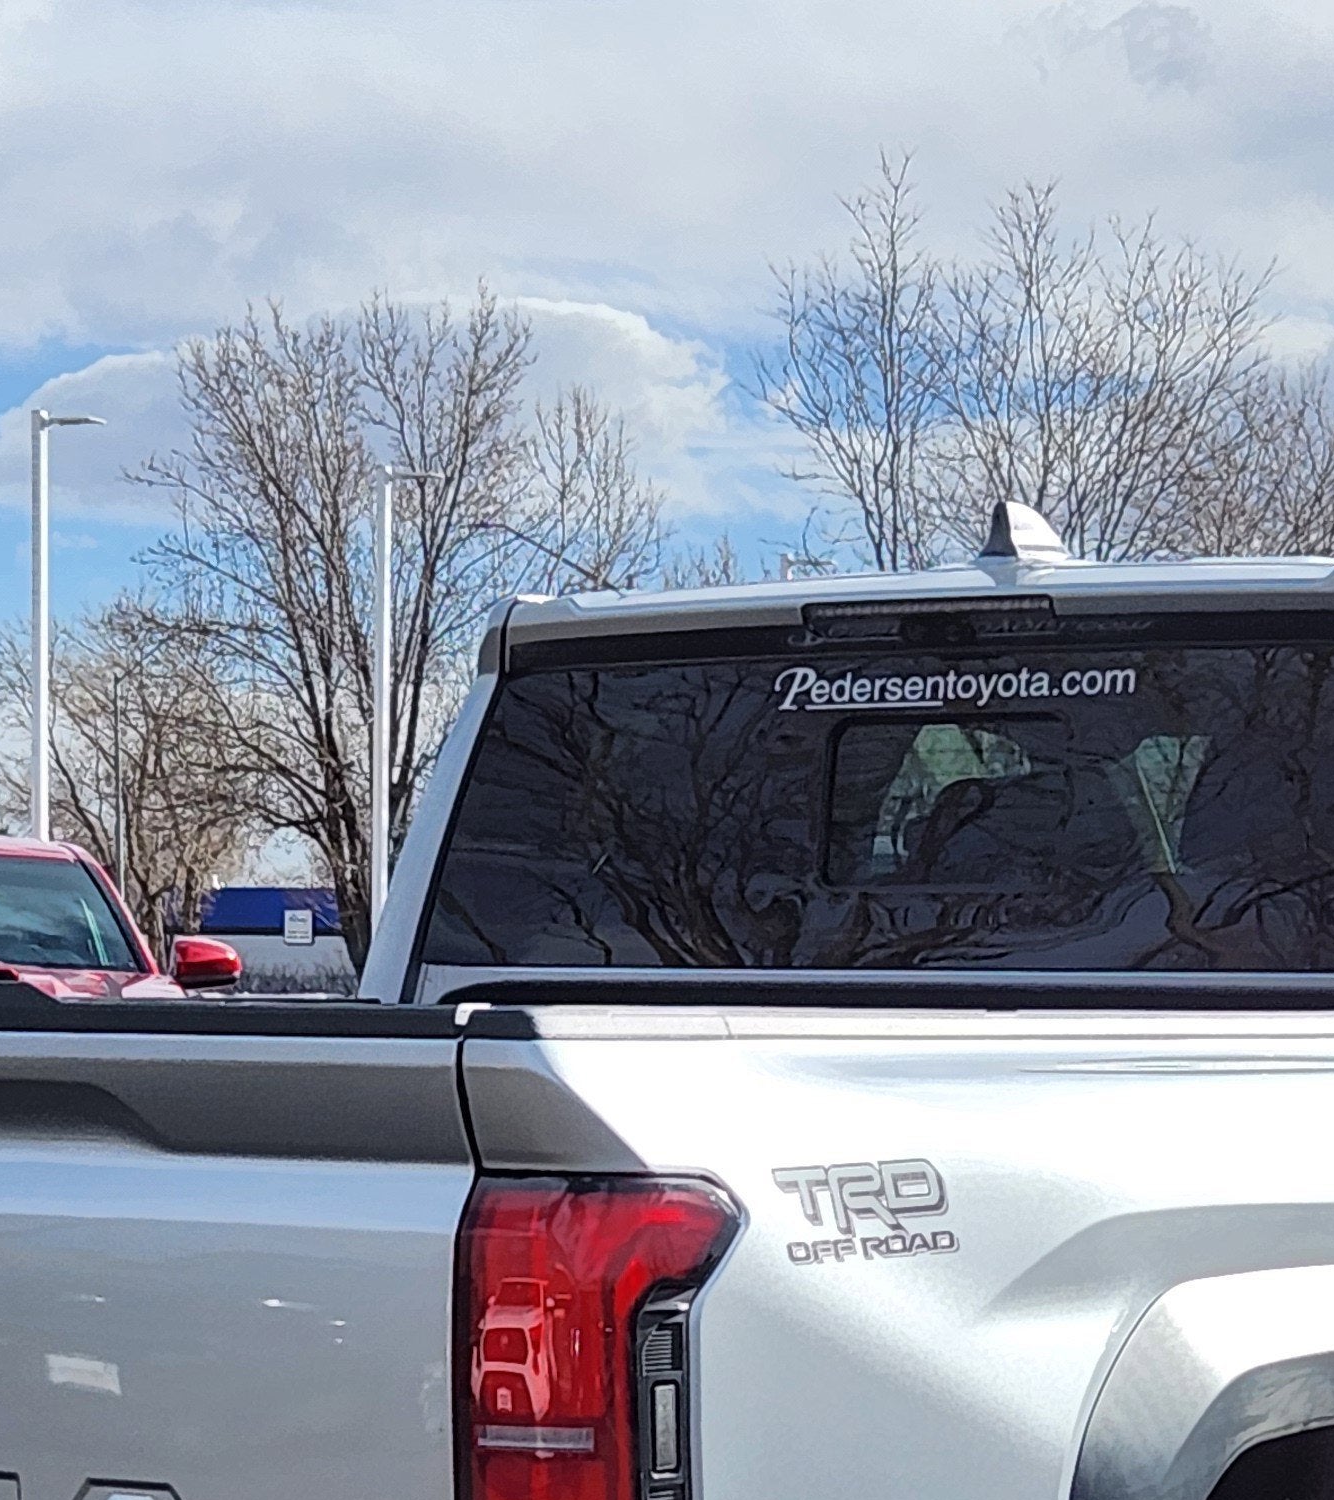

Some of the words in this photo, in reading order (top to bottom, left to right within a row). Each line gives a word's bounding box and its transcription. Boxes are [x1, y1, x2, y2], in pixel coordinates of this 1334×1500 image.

[774, 666, 1137, 711] Pedersentoyota.com
[771, 1158, 949, 1237] TRD
[786, 1238, 857, 1265] OFF
[860, 1230, 960, 1260] ROAD
